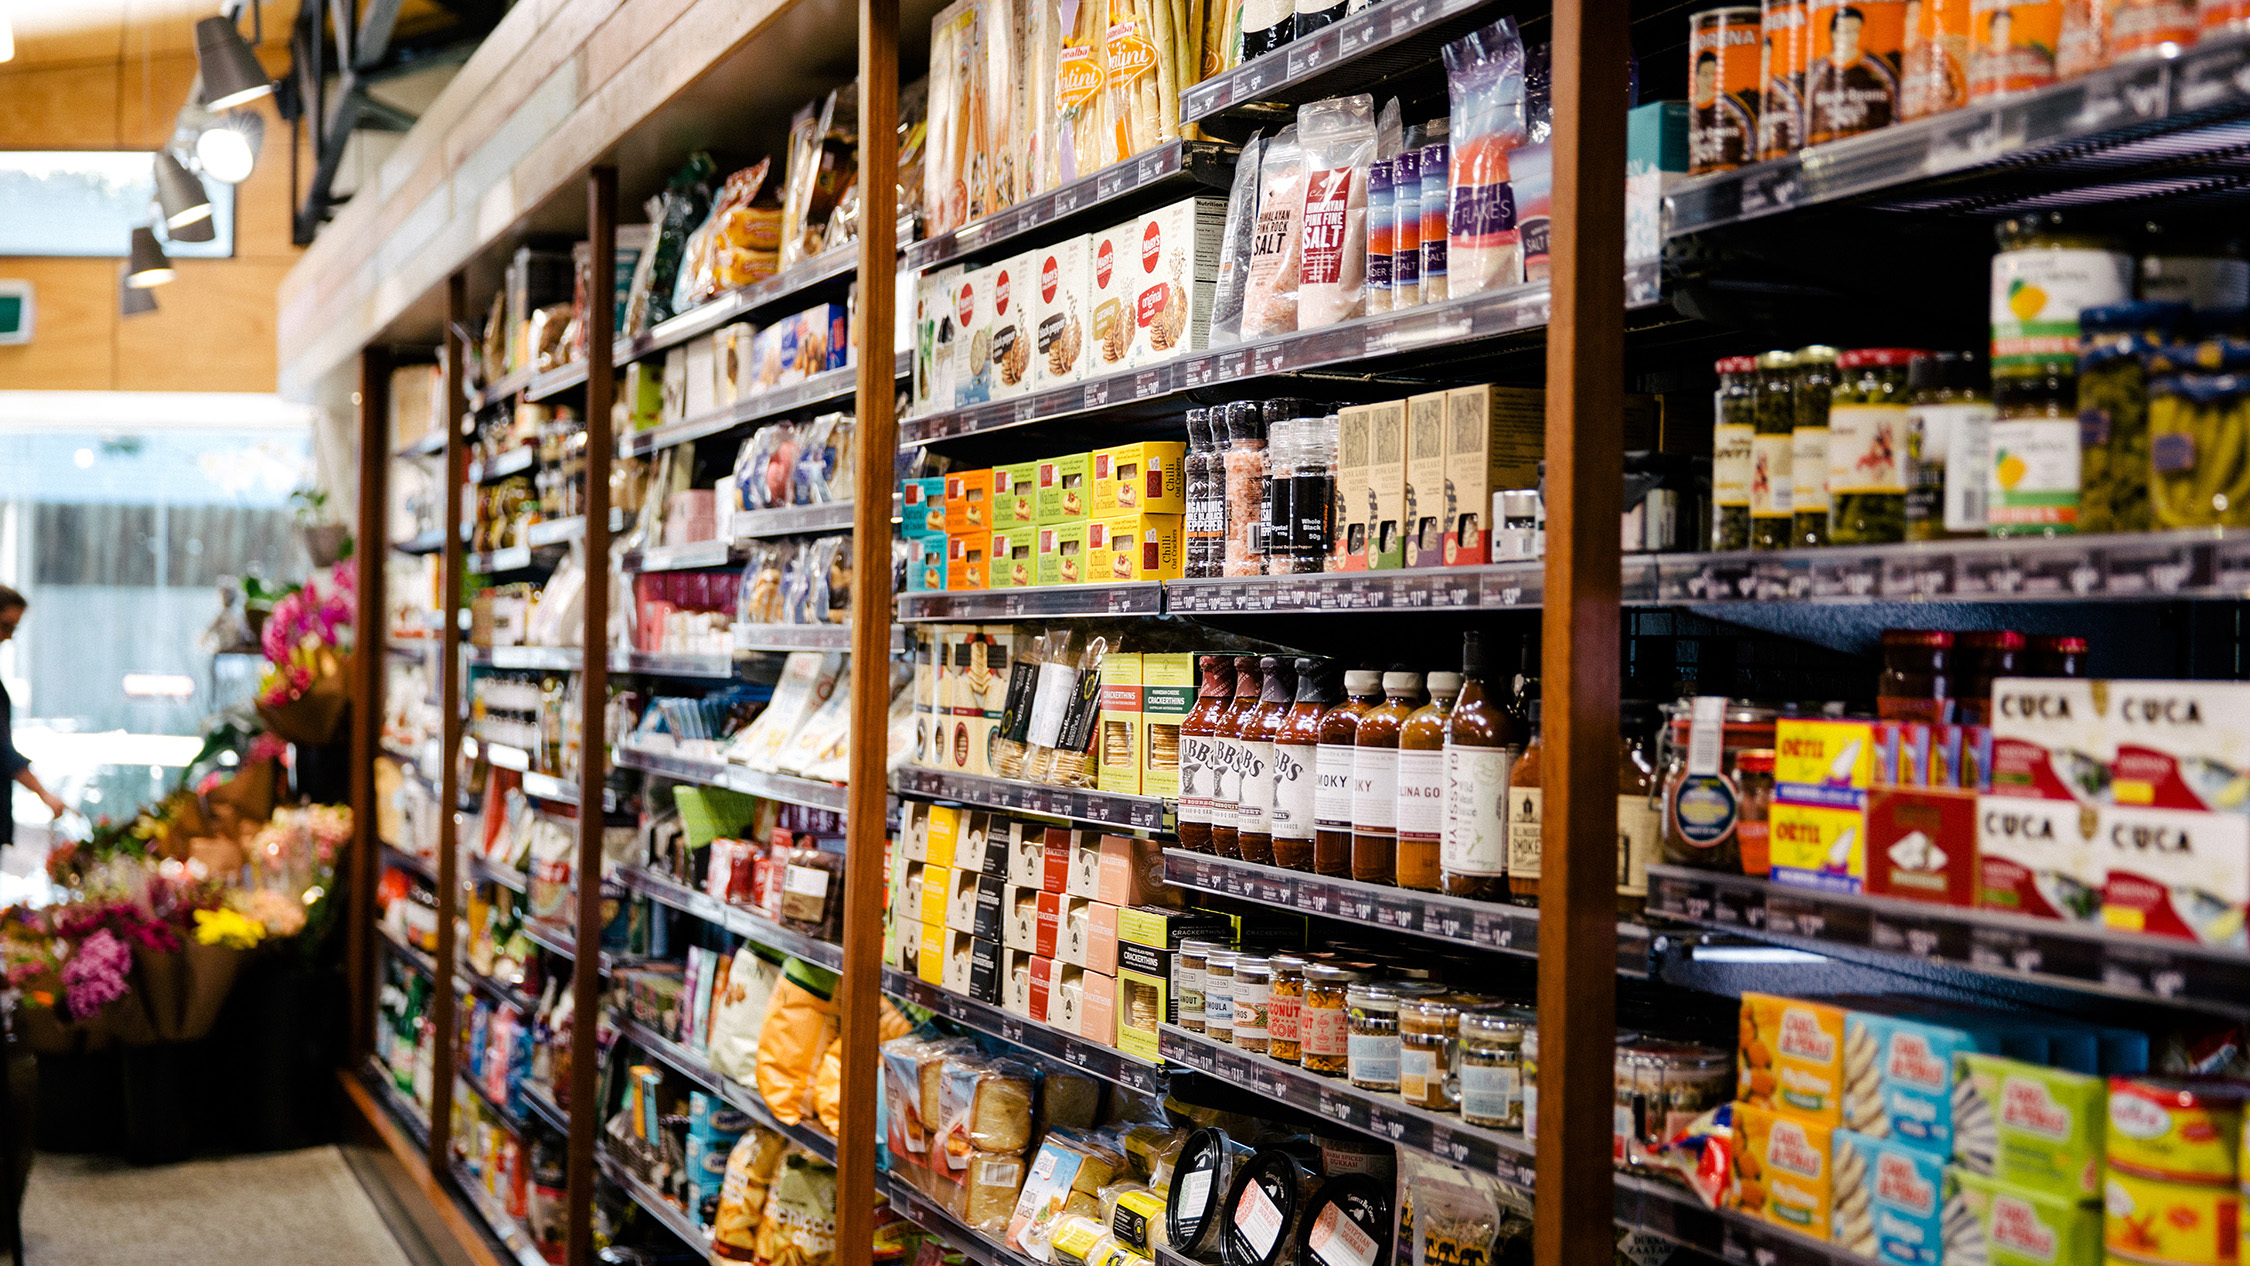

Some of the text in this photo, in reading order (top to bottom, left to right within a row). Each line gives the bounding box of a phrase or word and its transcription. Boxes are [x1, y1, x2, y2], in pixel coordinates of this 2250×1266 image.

[1196, 200, 1224, 208] Nutrition
[1461, 200, 1511, 225] FLAKES
[1259, 210, 1290, 222] HIMALAYAN
[1305, 212, 1344, 227] PINK FINE
[1271, 221, 1289, 233] ROCK
[1303, 225, 1343, 249] SALT
[1253, 233, 1287, 257] SALT
[1142, 287, 1162, 308] original
[1166, 463, 1175, 492] Chilli
[1162, 535, 1171, 563] Chilli
[1103, 691, 1136, 700] CRACKERTHINS
[1147, 696, 1185, 705] CRACKERTHINS
[2001, 695, 2071, 717] CUCA
[2121, 701, 2202, 722] CUCA
[1424, 787, 1441, 798] GO
[1985, 813, 2054, 840] CUCA
[1513, 838, 1541, 855] SMOKE
[2111, 824, 2194, 852] CUCA
[1123, 951, 1158, 967] CRACKERTHINS
[1330, 1159, 1358, 1169] DUKKAH
[1340, 1153, 1364, 1162] SPICED
[1341, 1229, 1365, 1256] DUKKAH
[1343, 1219, 1371, 1249] EGYPTIAN
